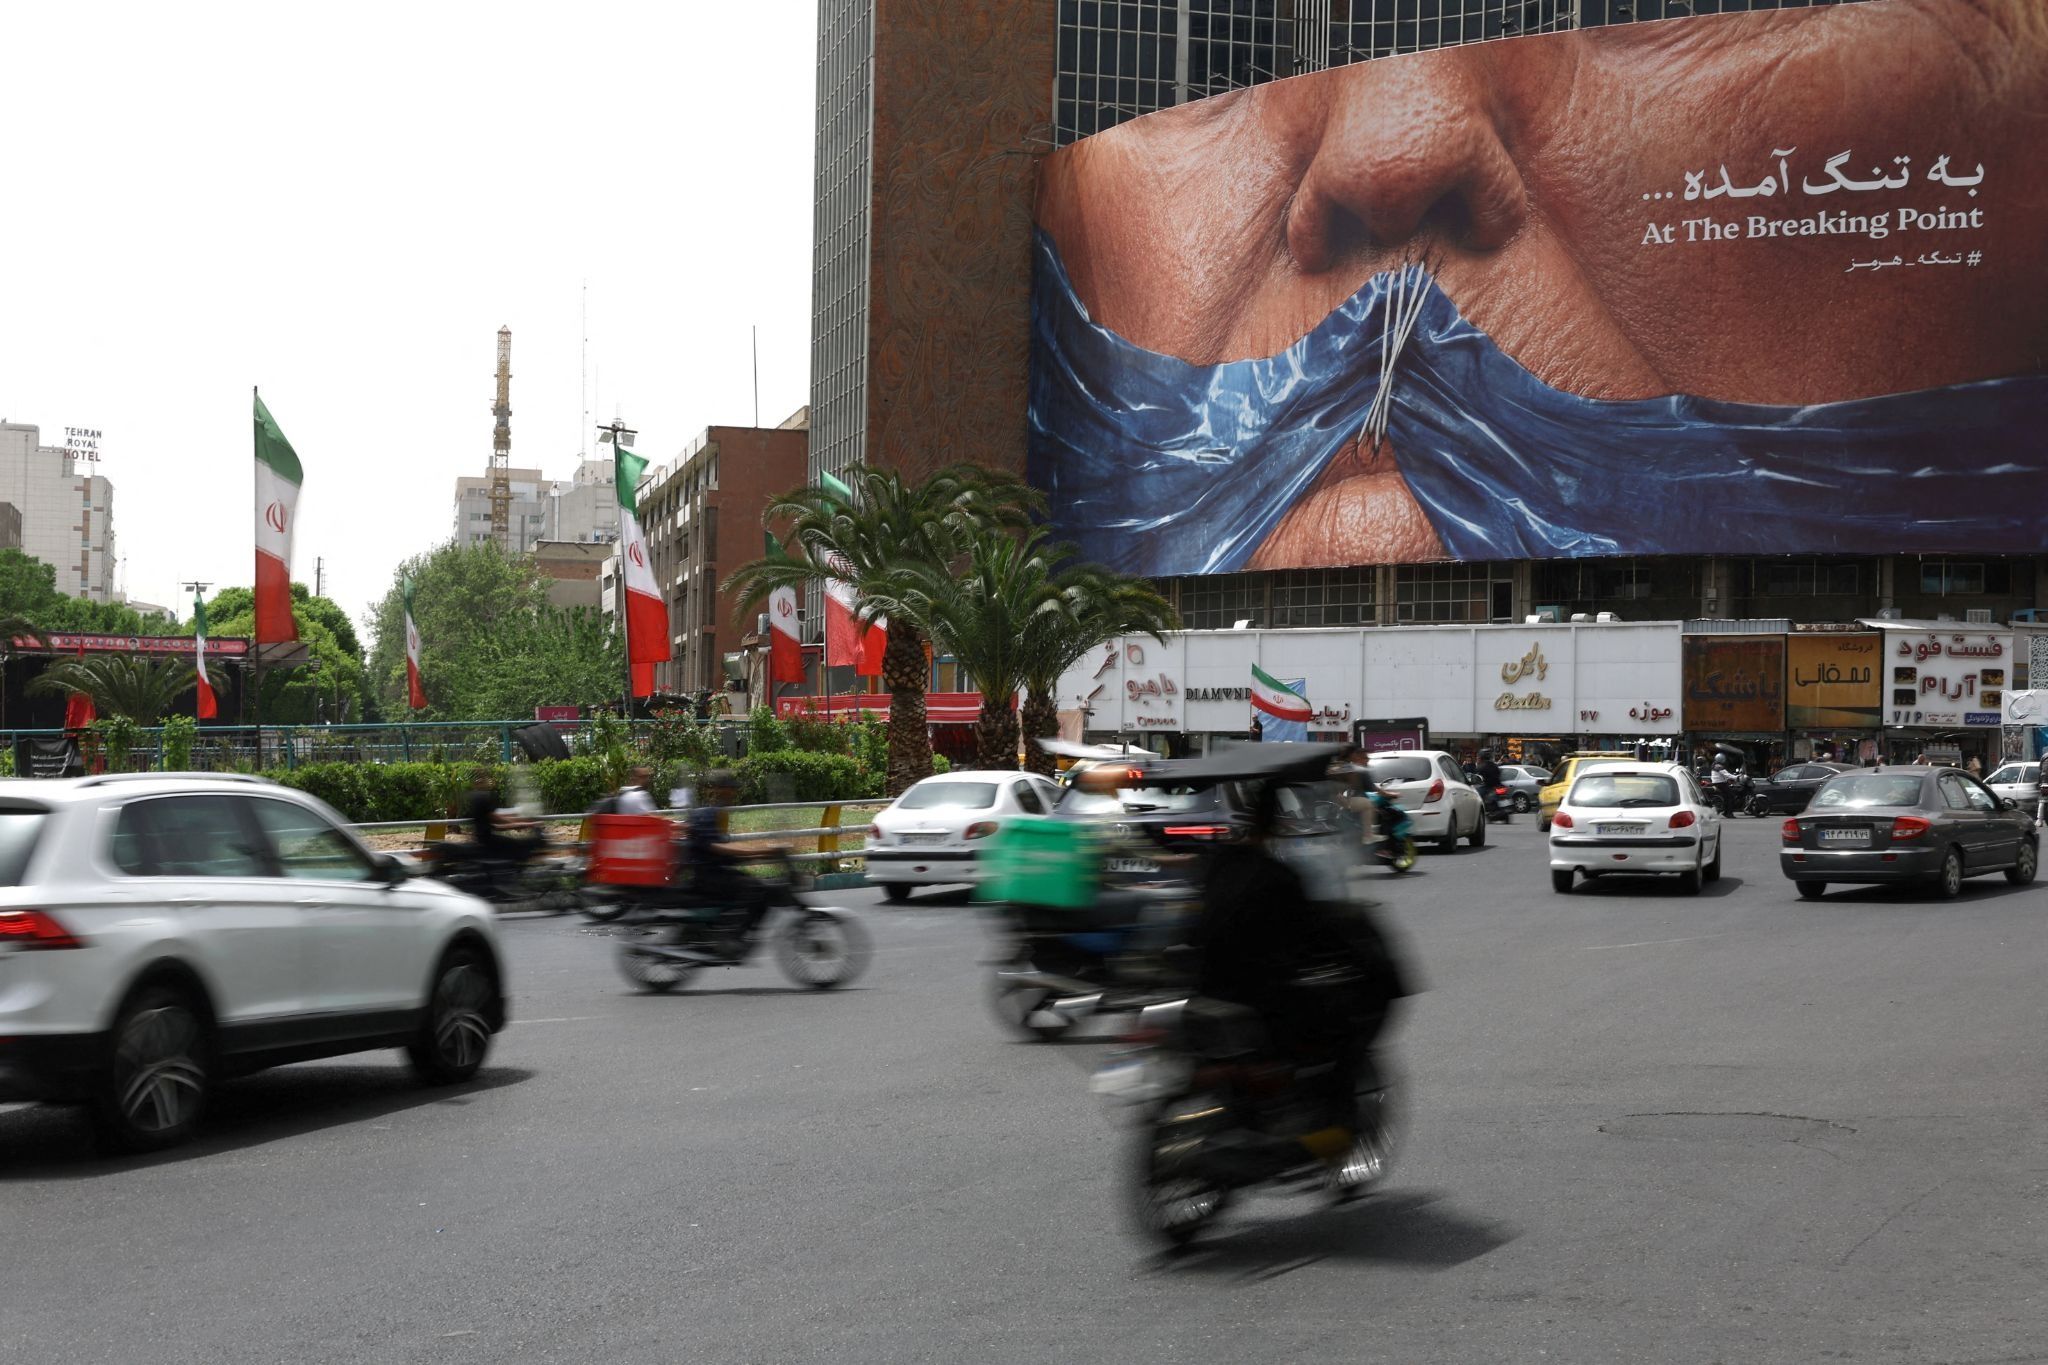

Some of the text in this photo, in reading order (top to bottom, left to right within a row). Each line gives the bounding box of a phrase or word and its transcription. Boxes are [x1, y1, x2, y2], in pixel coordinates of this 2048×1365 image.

[1683, 146, 1797, 201] آمده
[1802, 149, 1911, 195] تنگ
[1926, 153, 1985, 198] به
[1641, 205, 1985, 245] At The Breaking Point
[64, 427, 102, 439] TEHRAN
[67, 438, 98, 449] ROYAL
[64, 449, 102, 462] HOTEL
[1898, 633, 2003, 662] فست فود
[1920, 674, 1978, 701] آرام
[1628, 701, 1673, 722] موزه
